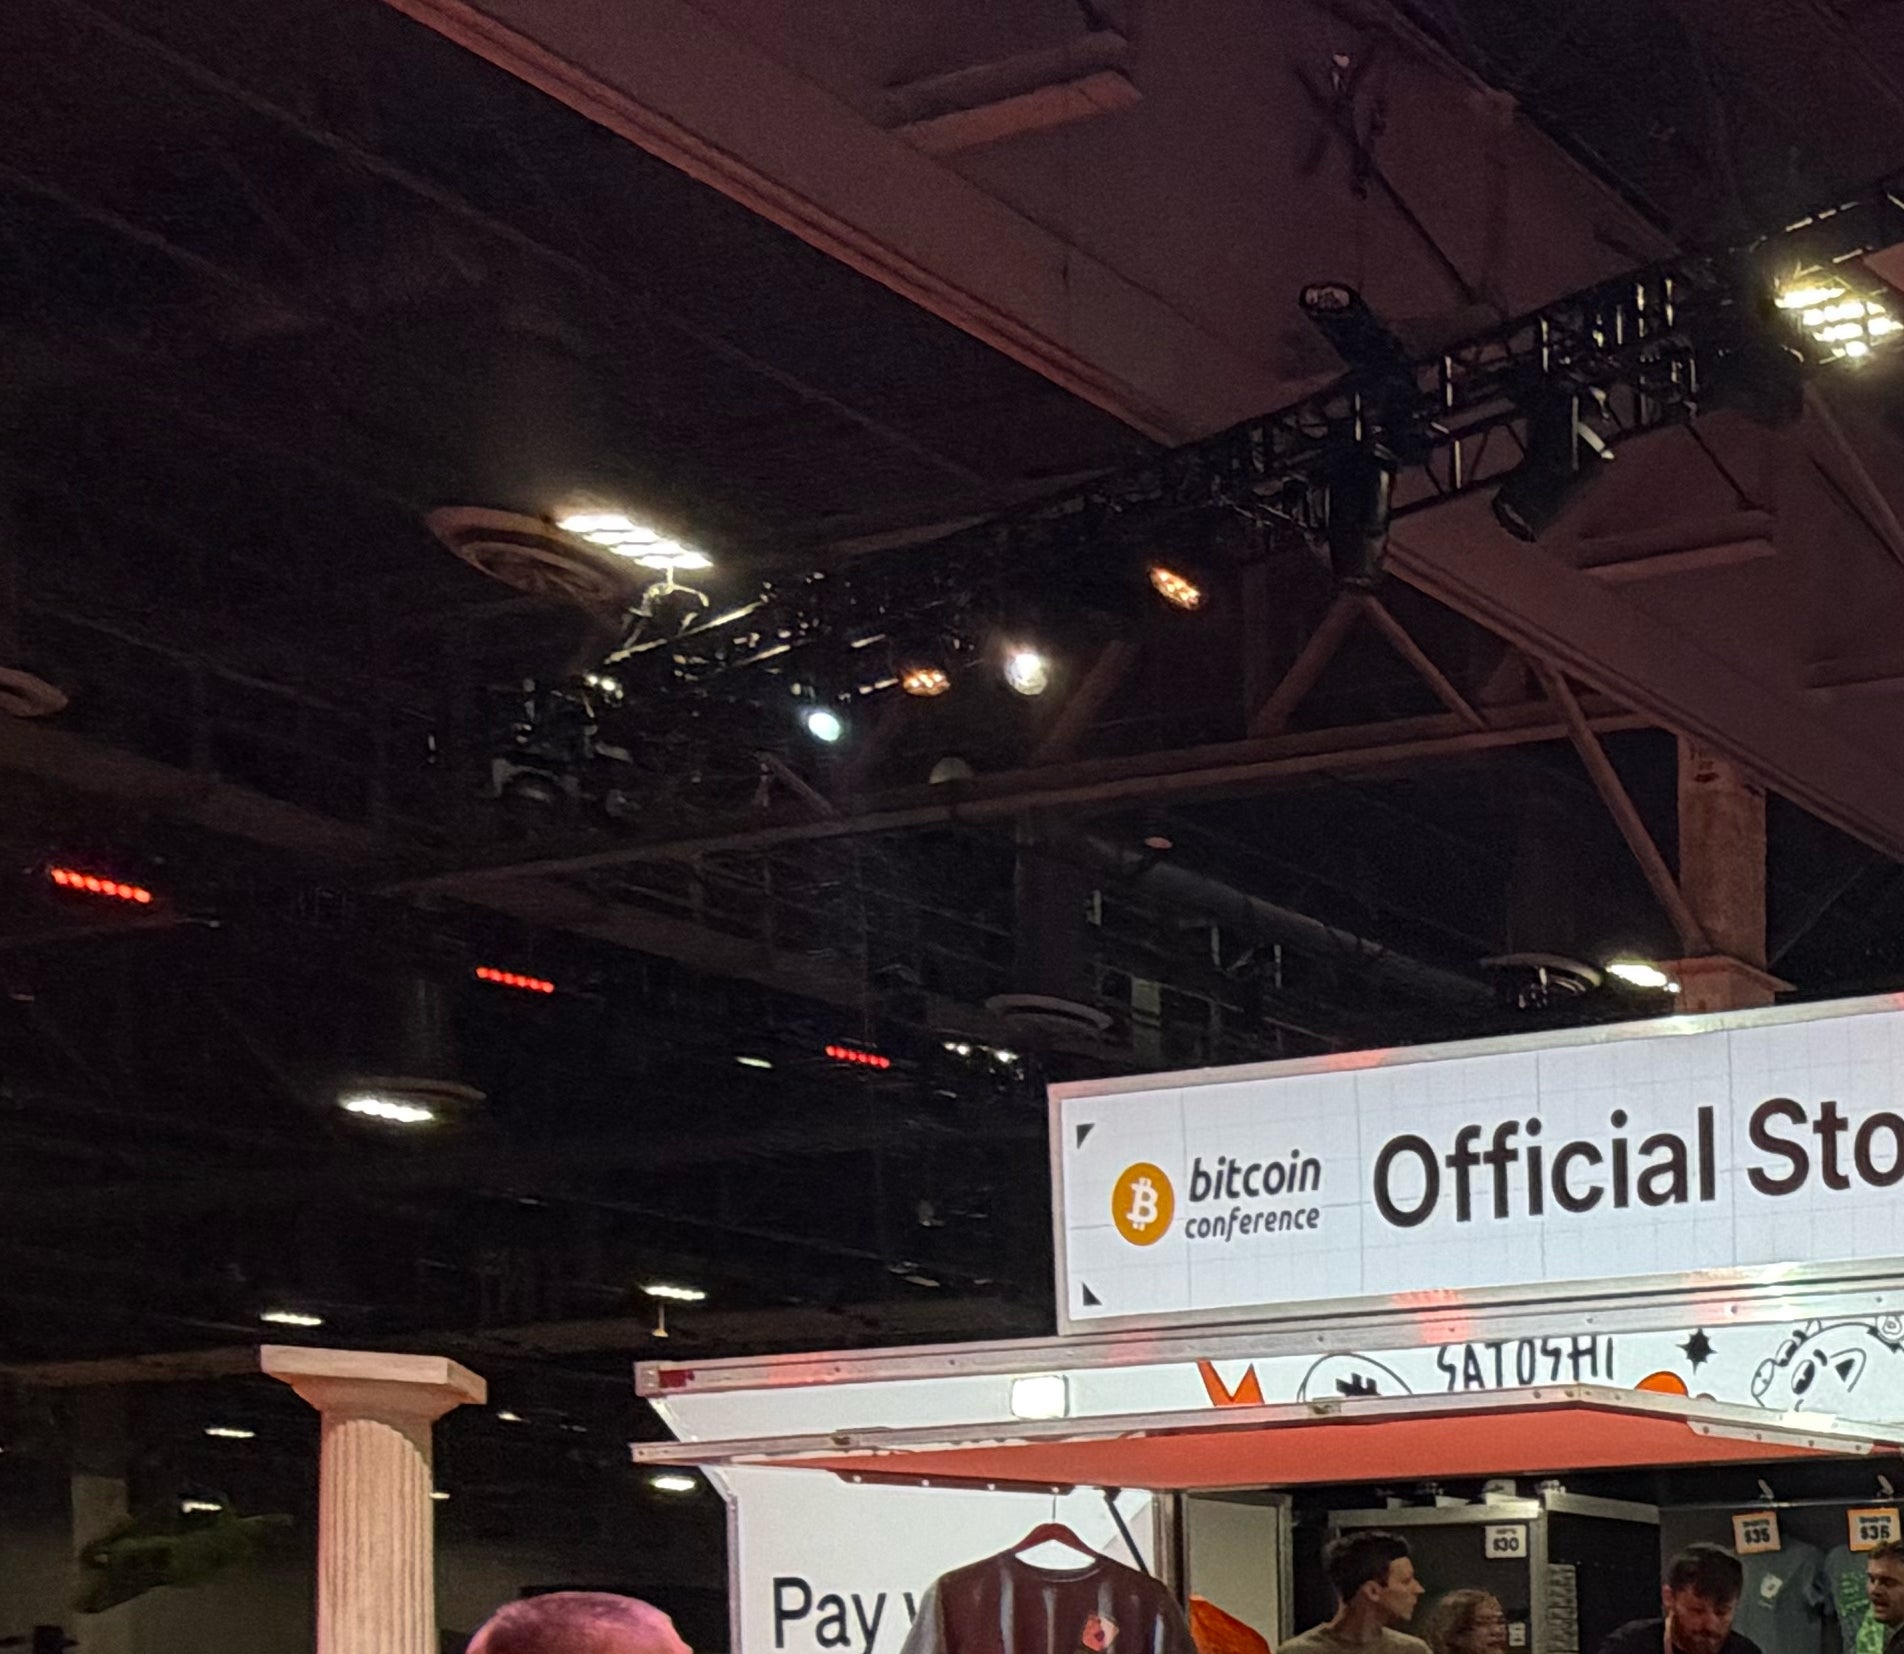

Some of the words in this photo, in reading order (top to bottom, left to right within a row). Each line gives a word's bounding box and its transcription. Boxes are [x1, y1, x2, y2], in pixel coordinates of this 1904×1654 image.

[1189, 1148, 1321, 1203] bitcoin
[1374, 1106, 1716, 1229] Official
[1185, 1206, 1320, 1243] conference
[1437, 1334, 1614, 1392] SATOSHI
